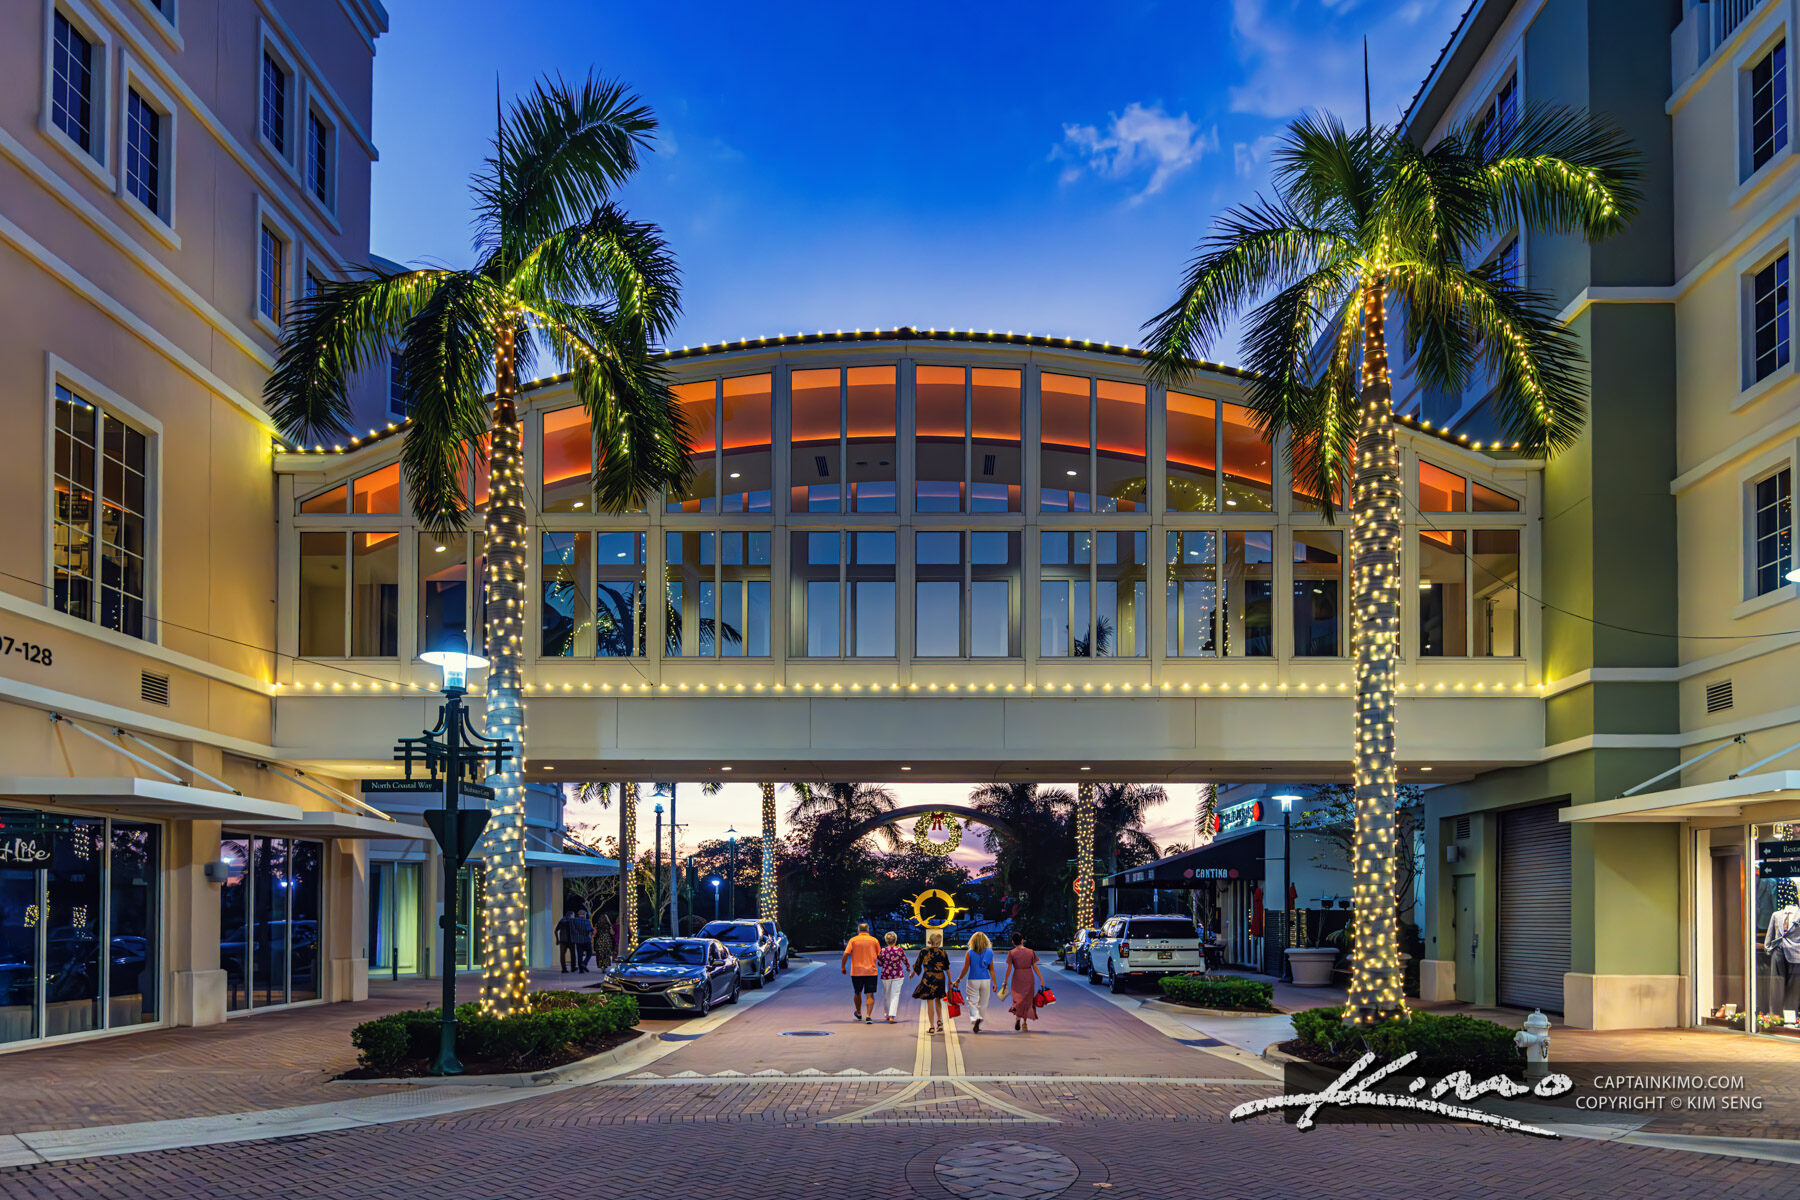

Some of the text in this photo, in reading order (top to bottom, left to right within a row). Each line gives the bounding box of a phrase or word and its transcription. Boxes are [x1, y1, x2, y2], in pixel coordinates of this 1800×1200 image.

[371, 781, 391, 789] North
[417, 781, 433, 790] Way
[12, 838, 51, 862] Life
[1195, 868, 1228, 879] CANTINA
